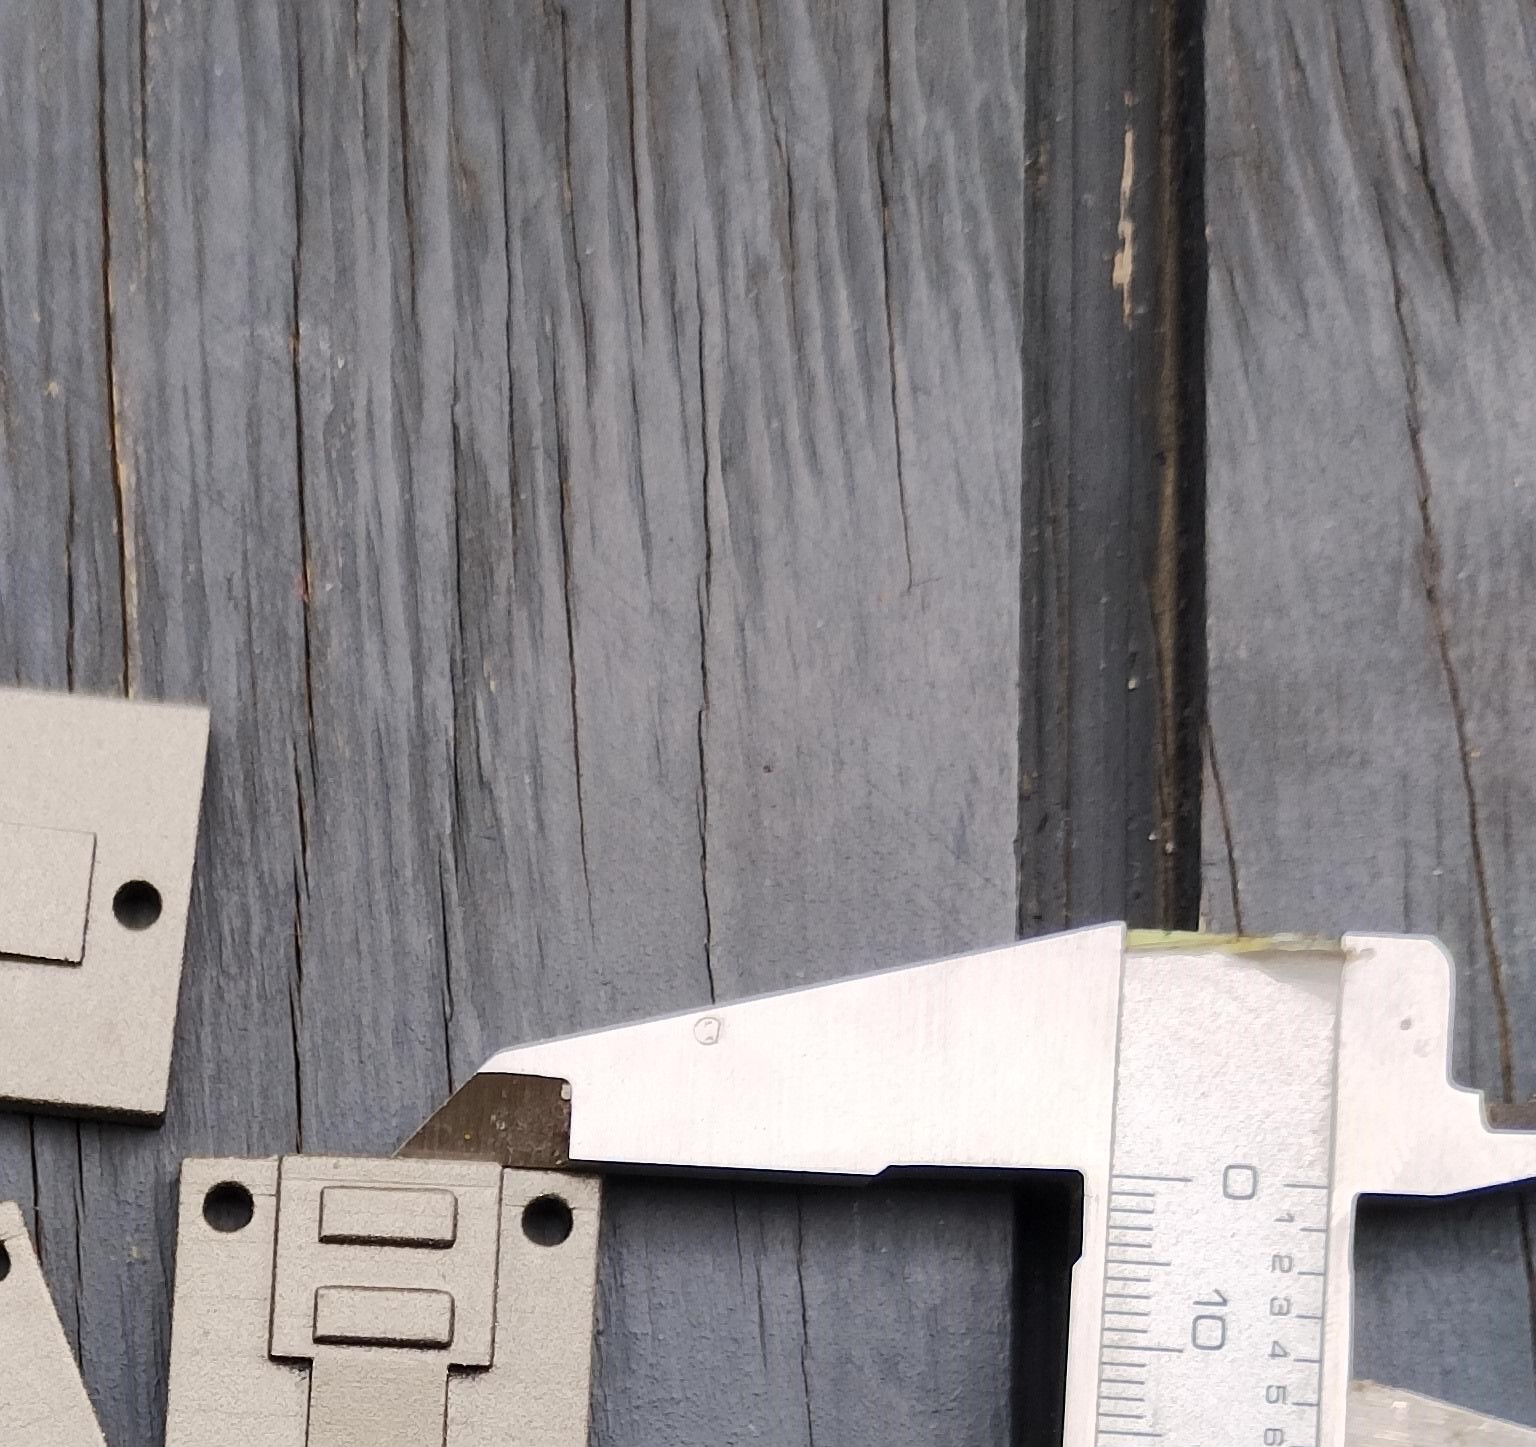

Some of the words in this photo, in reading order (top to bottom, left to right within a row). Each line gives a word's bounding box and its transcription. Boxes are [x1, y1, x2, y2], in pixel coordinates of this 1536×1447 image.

[1222, 1164, 1257, 1200] 0
[1274, 1212, 1295, 1224] 1
[1271, 1253, 1294, 1274] 2
[1269, 1296, 1292, 1317] 3
[1191, 1289, 1229, 1351] 10
[1267, 1340, 1288, 1360] 4
[1265, 1384, 1287, 1405] 5
[1263, 1428, 1286, 1447] 6
